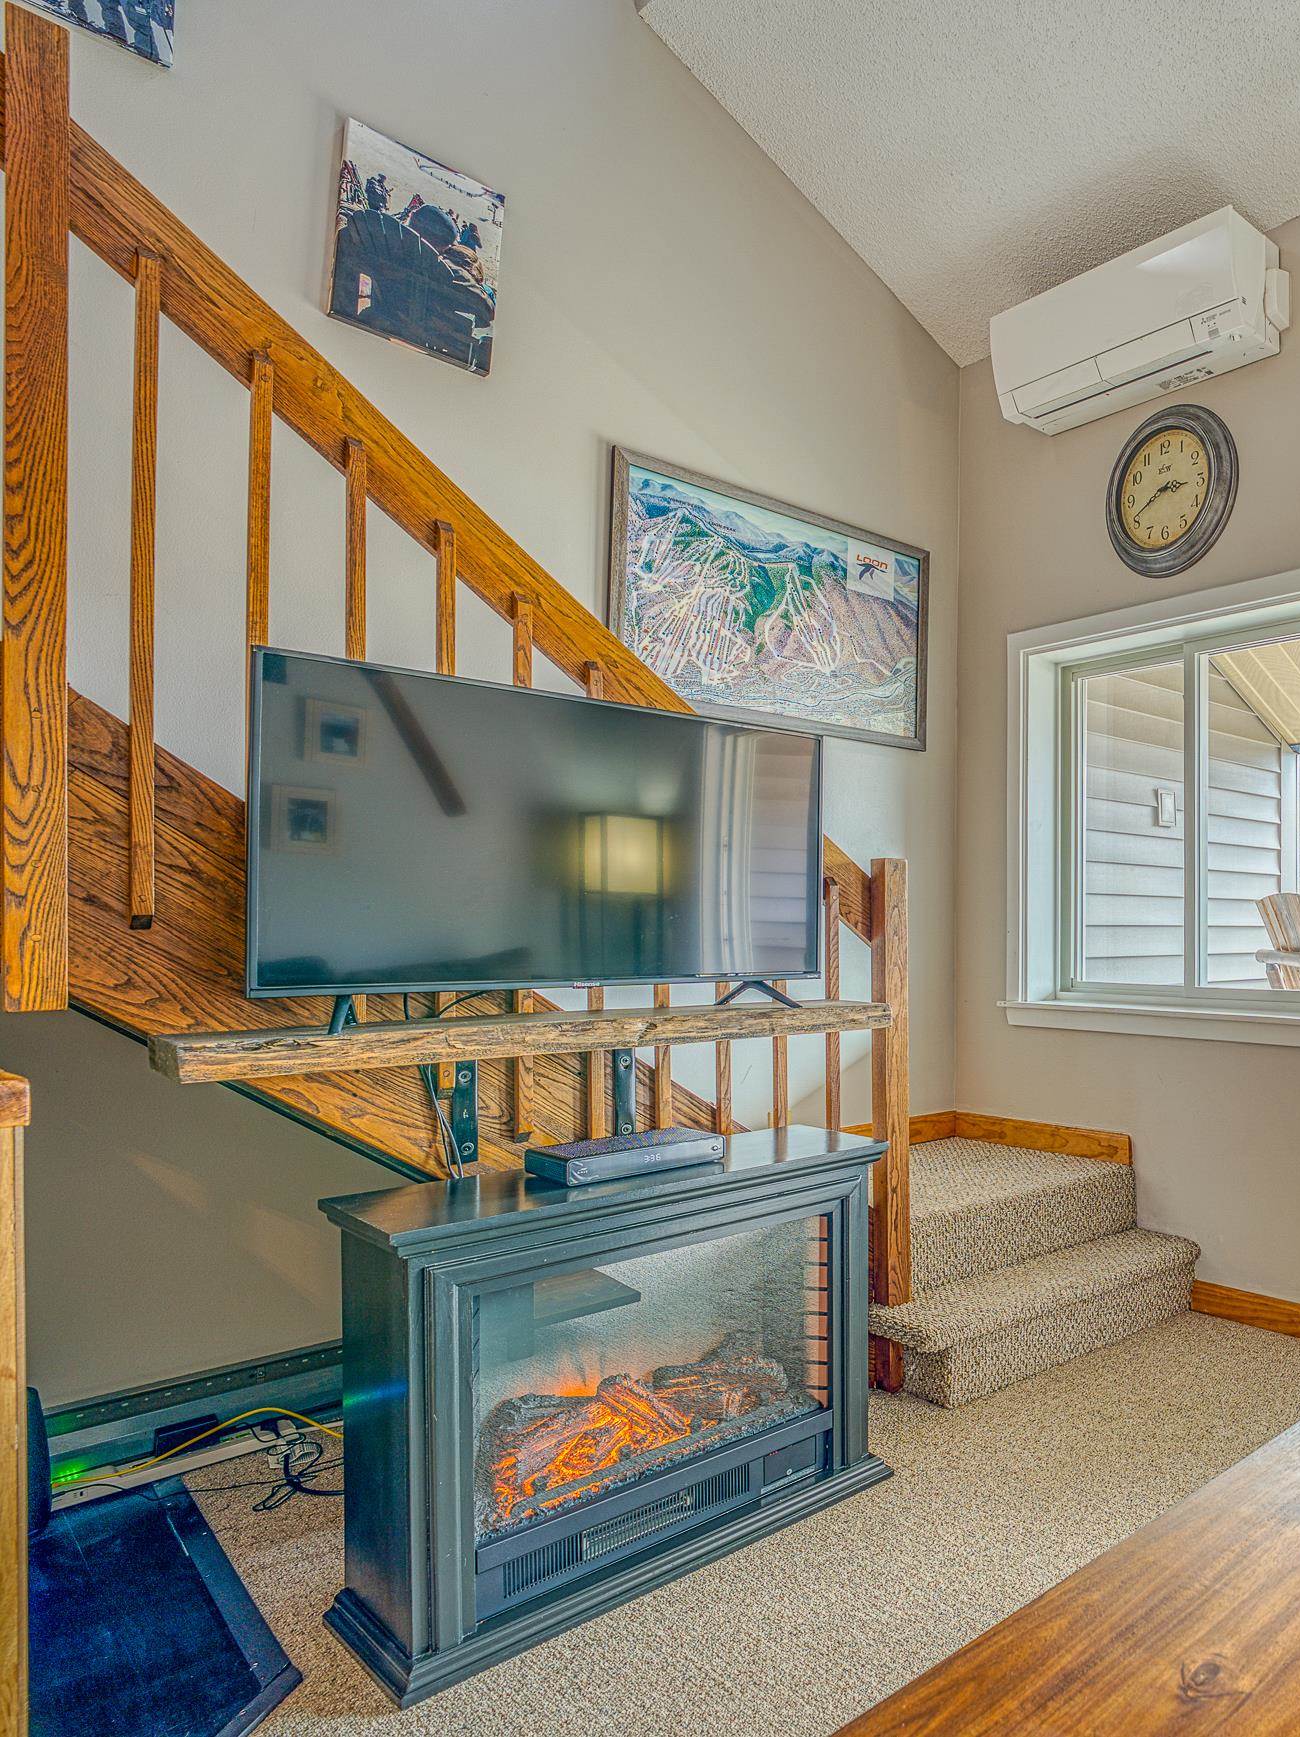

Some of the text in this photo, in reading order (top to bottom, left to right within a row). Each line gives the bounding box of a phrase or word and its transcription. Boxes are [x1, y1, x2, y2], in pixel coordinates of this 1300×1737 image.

[1159, 439, 1171, 456] 12
[1179, 440, 1184, 453] 1
[1143, 453, 1151, 467] 11
[1190, 450, 1199, 466] 2
[1132, 470, 1143, 486] 10
[1196, 471, 1205, 487] 3
[1127, 494, 1136, 509] 9
[1190, 494, 1201, 508] 4
[1133, 515, 1141, 530] 8
[1179, 514, 1188, 529] 5
[1146, 526, 1154, 540] 7
[1160, 525, 1170, 541] 6
